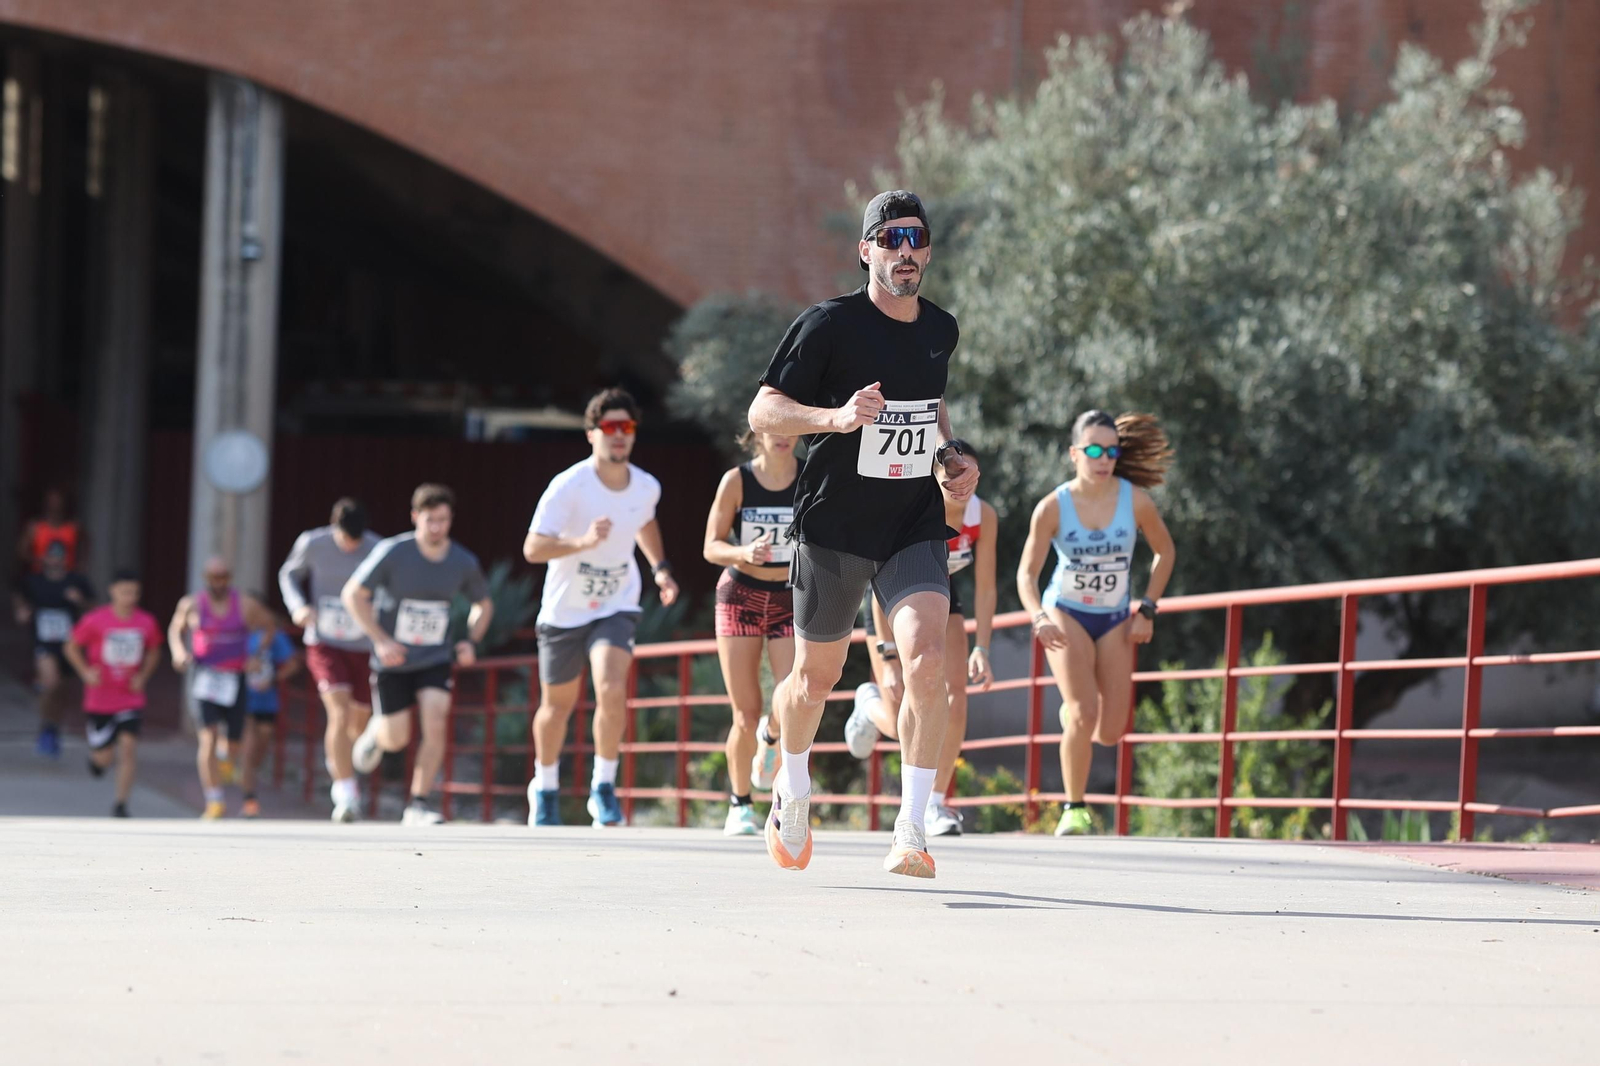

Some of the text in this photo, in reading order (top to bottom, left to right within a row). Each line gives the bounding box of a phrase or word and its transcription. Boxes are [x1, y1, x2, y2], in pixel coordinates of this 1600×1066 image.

[878, 428, 926, 456] 701
[1072, 541, 1122, 555] nerja
[1073, 574, 1117, 593] 549
